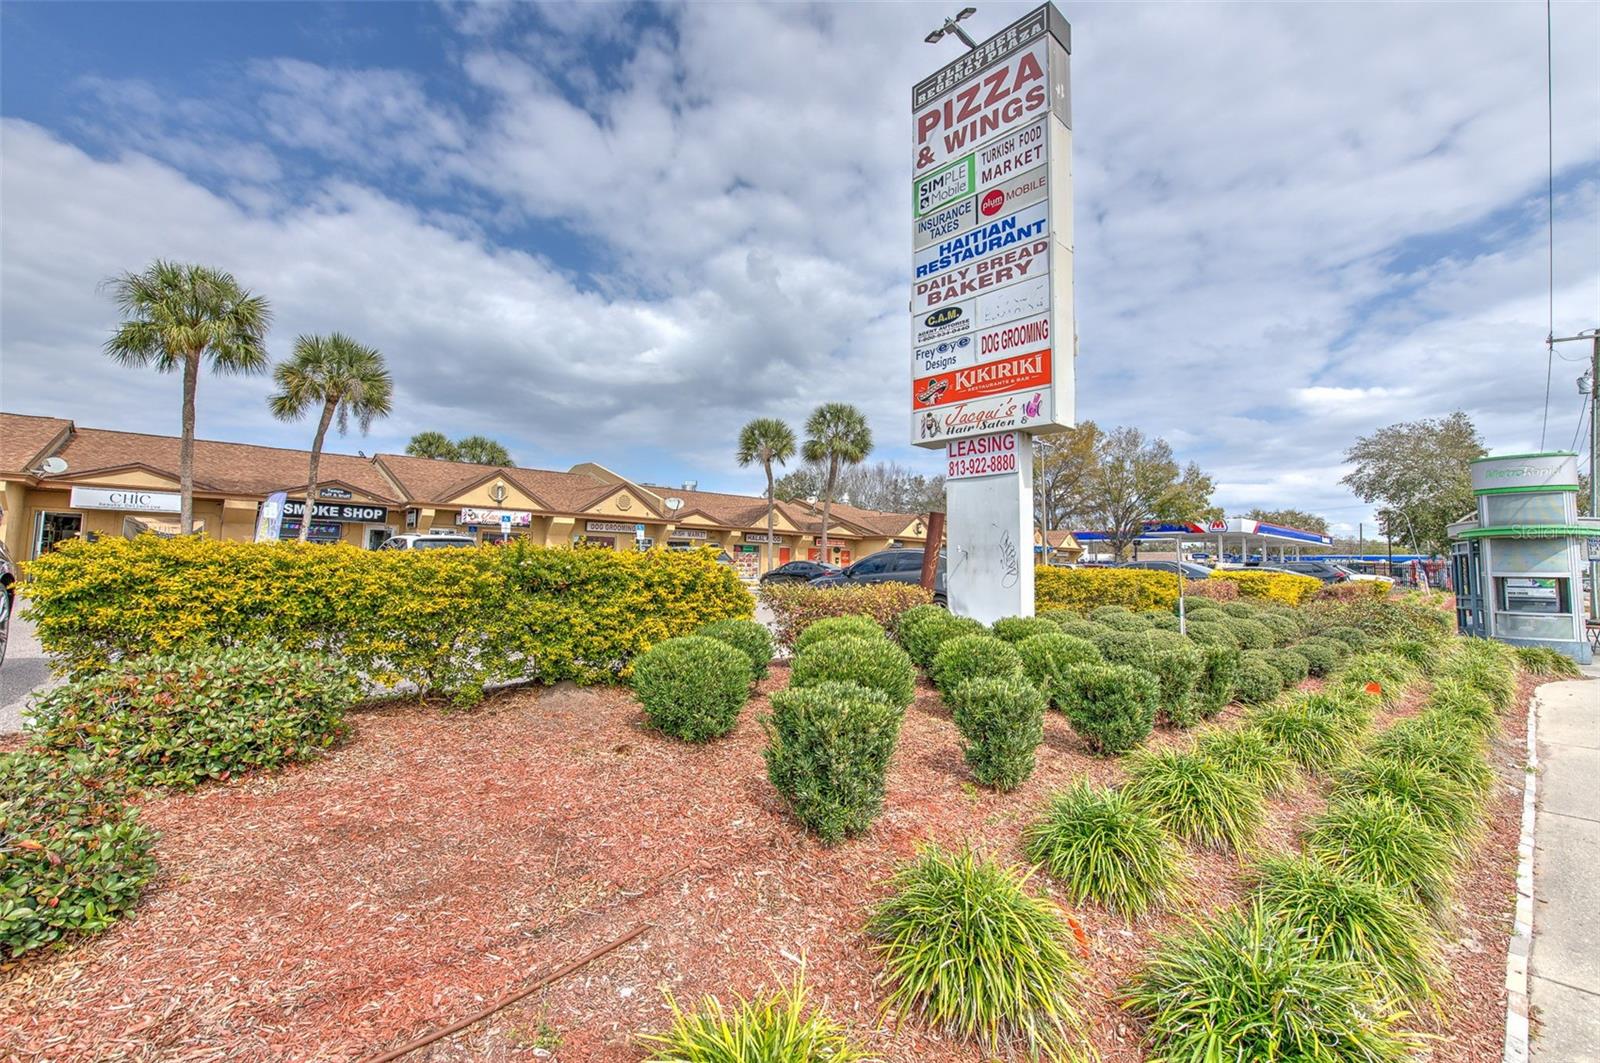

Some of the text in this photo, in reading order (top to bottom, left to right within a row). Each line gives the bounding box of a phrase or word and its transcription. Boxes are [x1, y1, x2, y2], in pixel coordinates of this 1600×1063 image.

[917, 23, 1042, 104] REGENCY PLAZA
[936, 26, 1017, 84] FLETCHER
[918, 52, 1044, 145] PIZZA
[917, 85, 1045, 169] & WINGS
[981, 126, 1042, 165] TURKISH FOOD
[920, 165, 966, 196] SIMPLE
[981, 144, 1043, 184] MARKET
[931, 181, 966, 205] Mobile
[982, 176, 1046, 211] plum MOBILE
[918, 201, 972, 234] INSURANCE
[930, 219, 960, 239] TAXES
[916, 219, 1047, 279] RESTAURANT
[939, 216, 1016, 257] HAITIAN
[917, 241, 1048, 296] DAILY BREAD
[927, 259, 1033, 306] BAKERY
[927, 309, 960, 325] C.A.M.
[916, 348, 936, 360] Frey
[981, 319, 1049, 355] DOG GROOMING
[925, 356, 957, 371] Designs
[945, 397, 1017, 428] Jacqui's
[946, 425, 975, 435] Hair
[979, 419, 1015, 431] Salon
[949, 434, 1015, 458] LEASING
[949, 454, 1015, 477] 813-922-8880
[343, 507, 383, 519] SHOP
